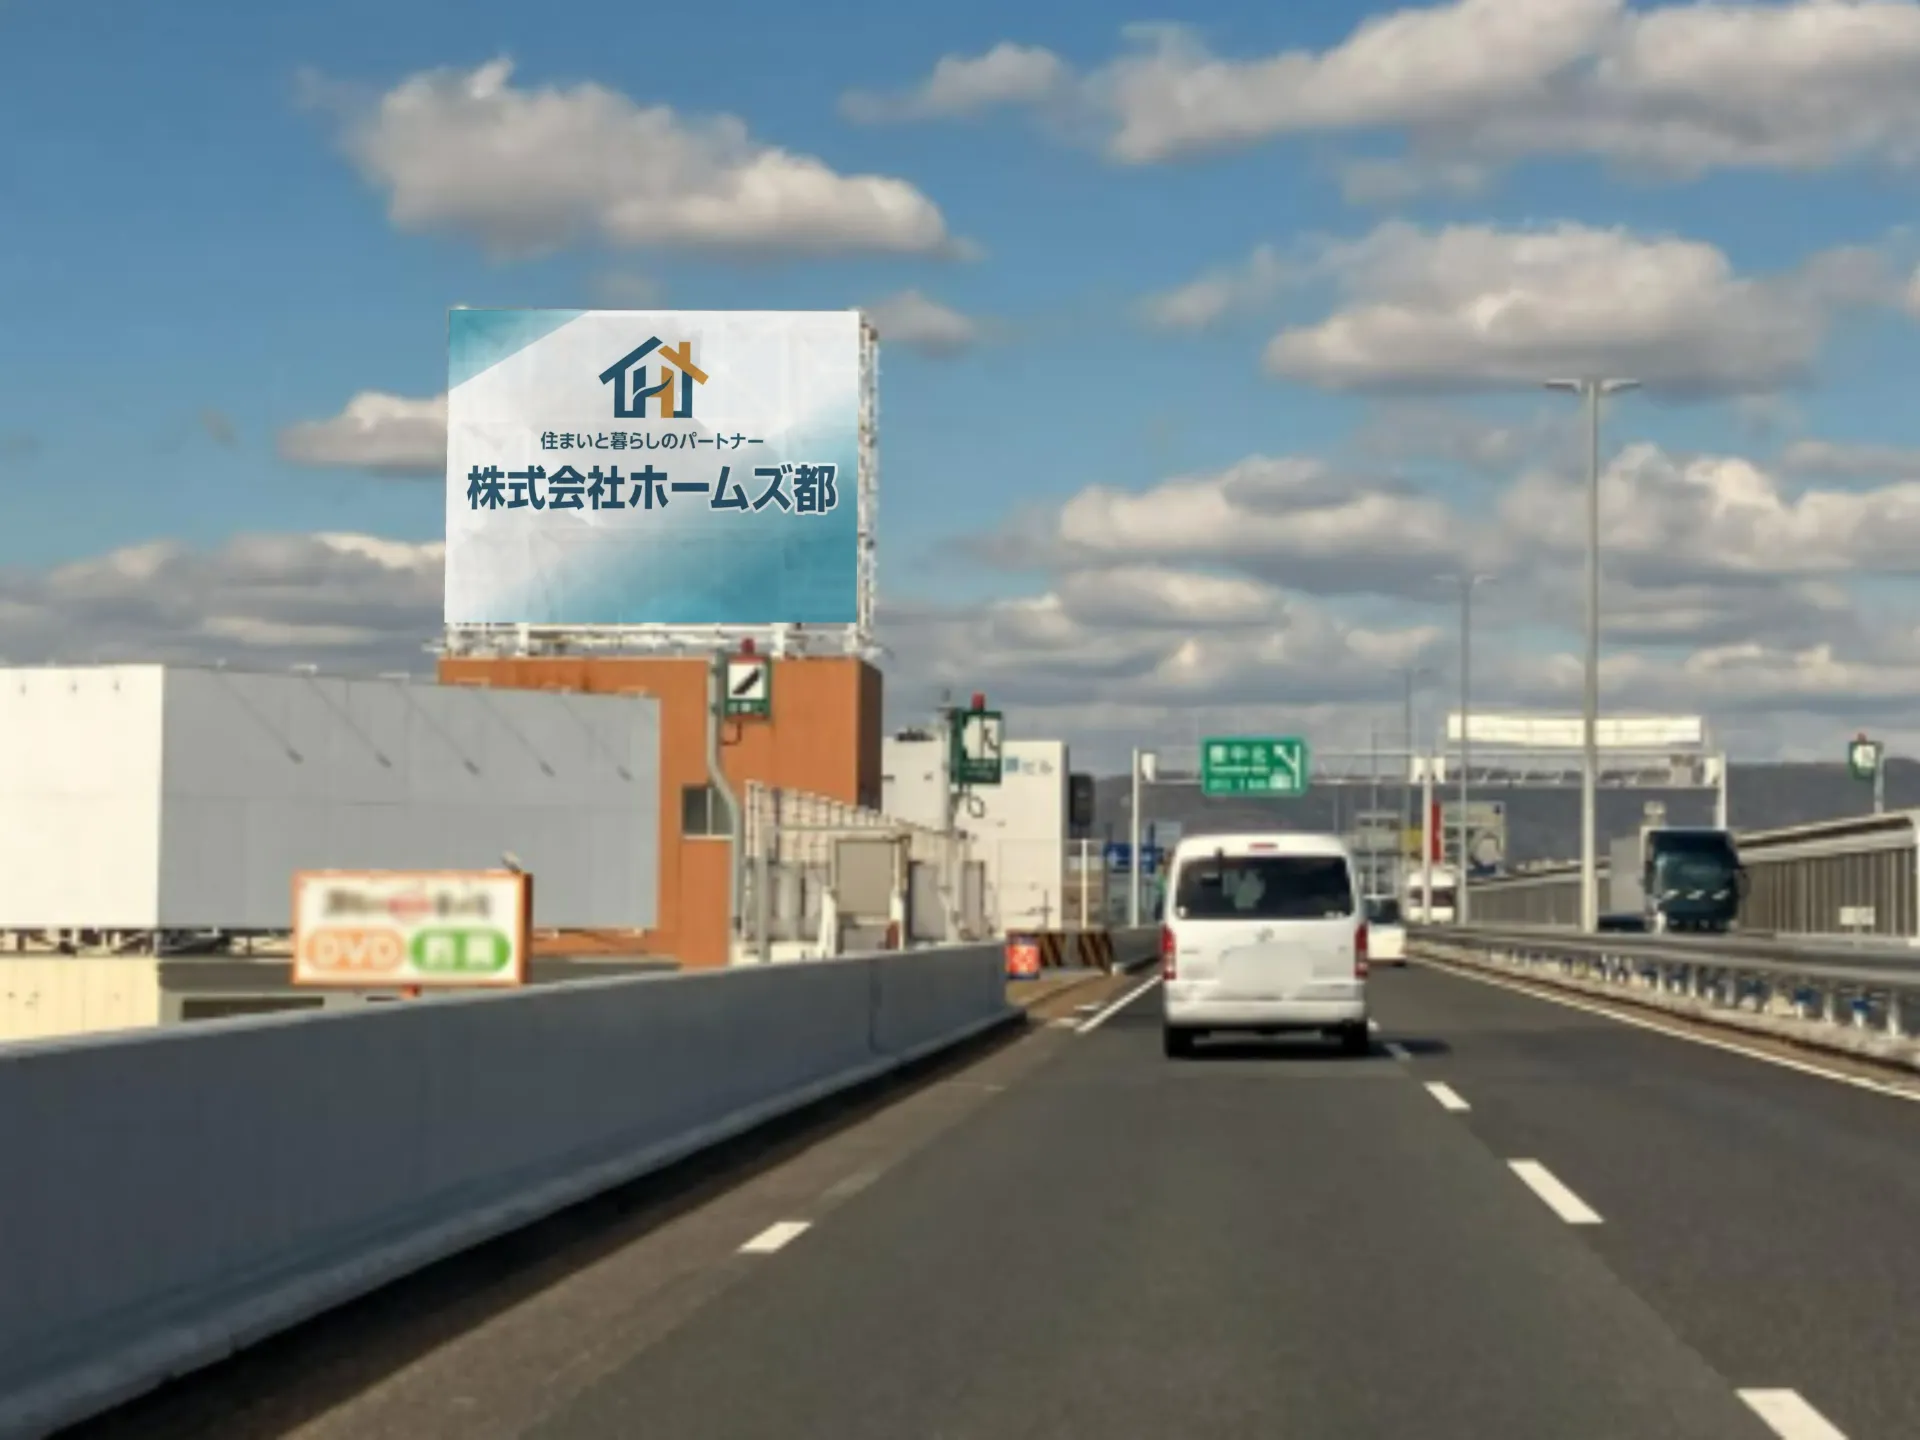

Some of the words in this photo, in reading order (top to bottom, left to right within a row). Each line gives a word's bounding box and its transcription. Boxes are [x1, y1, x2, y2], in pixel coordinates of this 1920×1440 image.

[540, 431, 764, 450] 住まいと暮らしのパートナー
[466, 465, 836, 513] 株式会社ホームズ都
[313, 933, 401, 965] DVD
